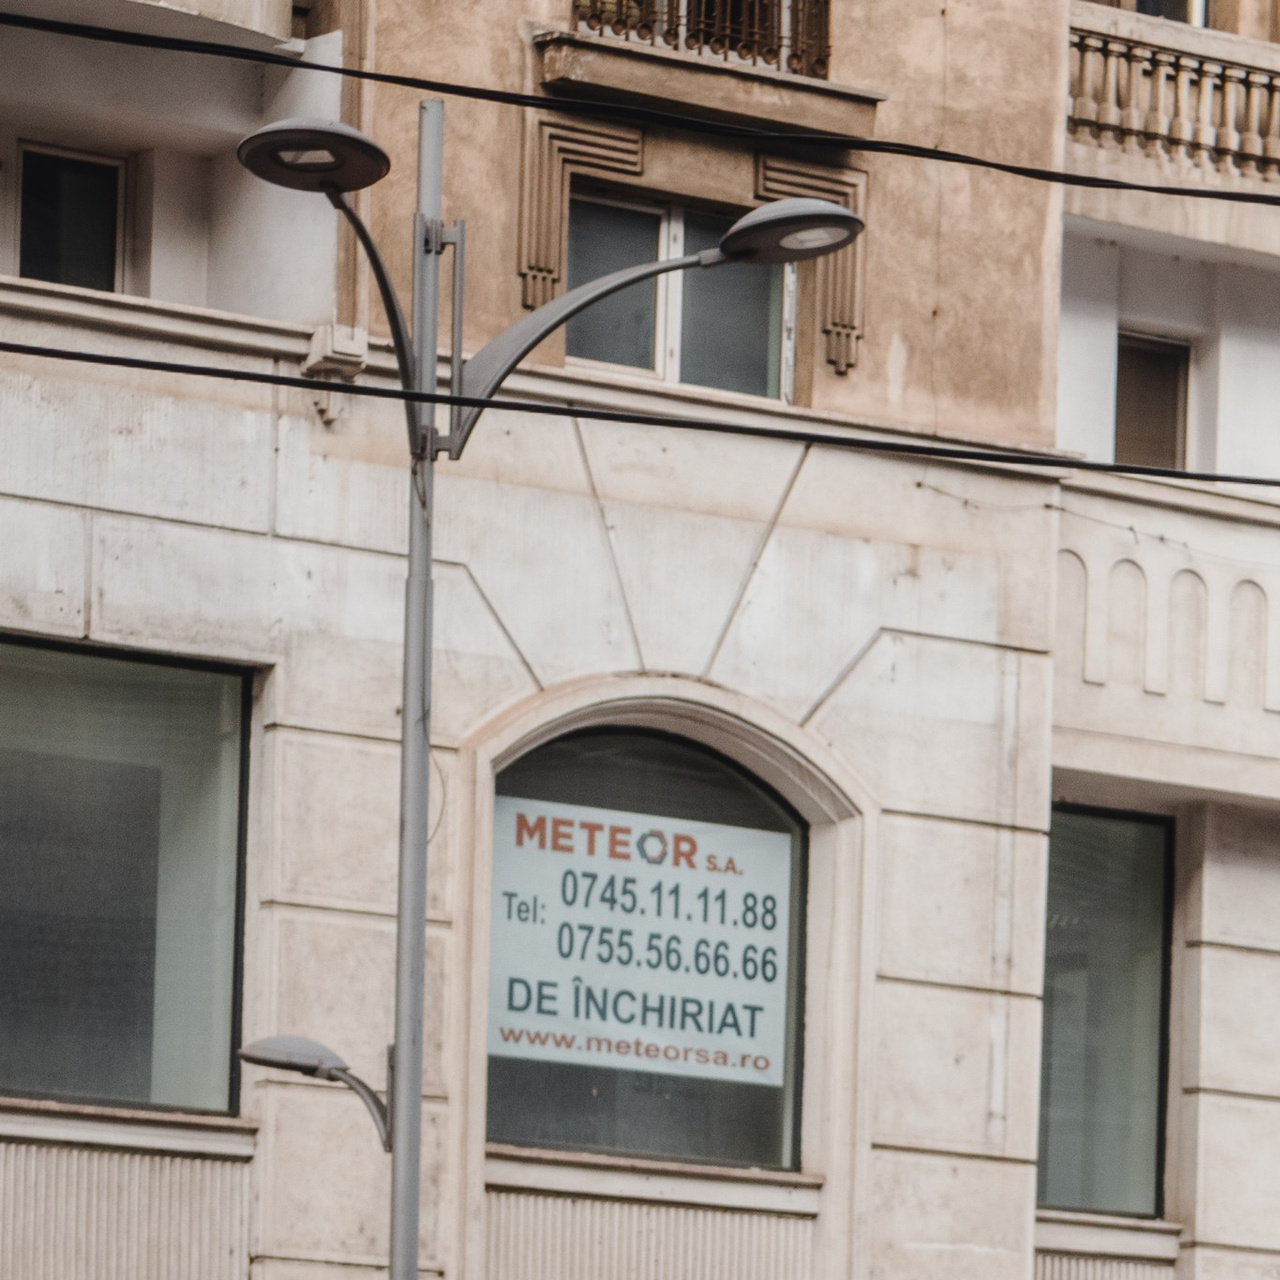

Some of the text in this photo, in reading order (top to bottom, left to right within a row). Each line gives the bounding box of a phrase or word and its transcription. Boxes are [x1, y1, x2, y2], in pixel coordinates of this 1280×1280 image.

[515, 813, 744, 876] METEOR S.A.
[502, 891, 546, 925] Tel:
[561, 869, 778, 932] 0745.11.11.88
[557, 922, 778, 983] 0755.56.66.66
[507, 976, 764, 1038] DE ÎNCHIRIAT
[499, 1026, 771, 1071] www.meteorsa.ro
